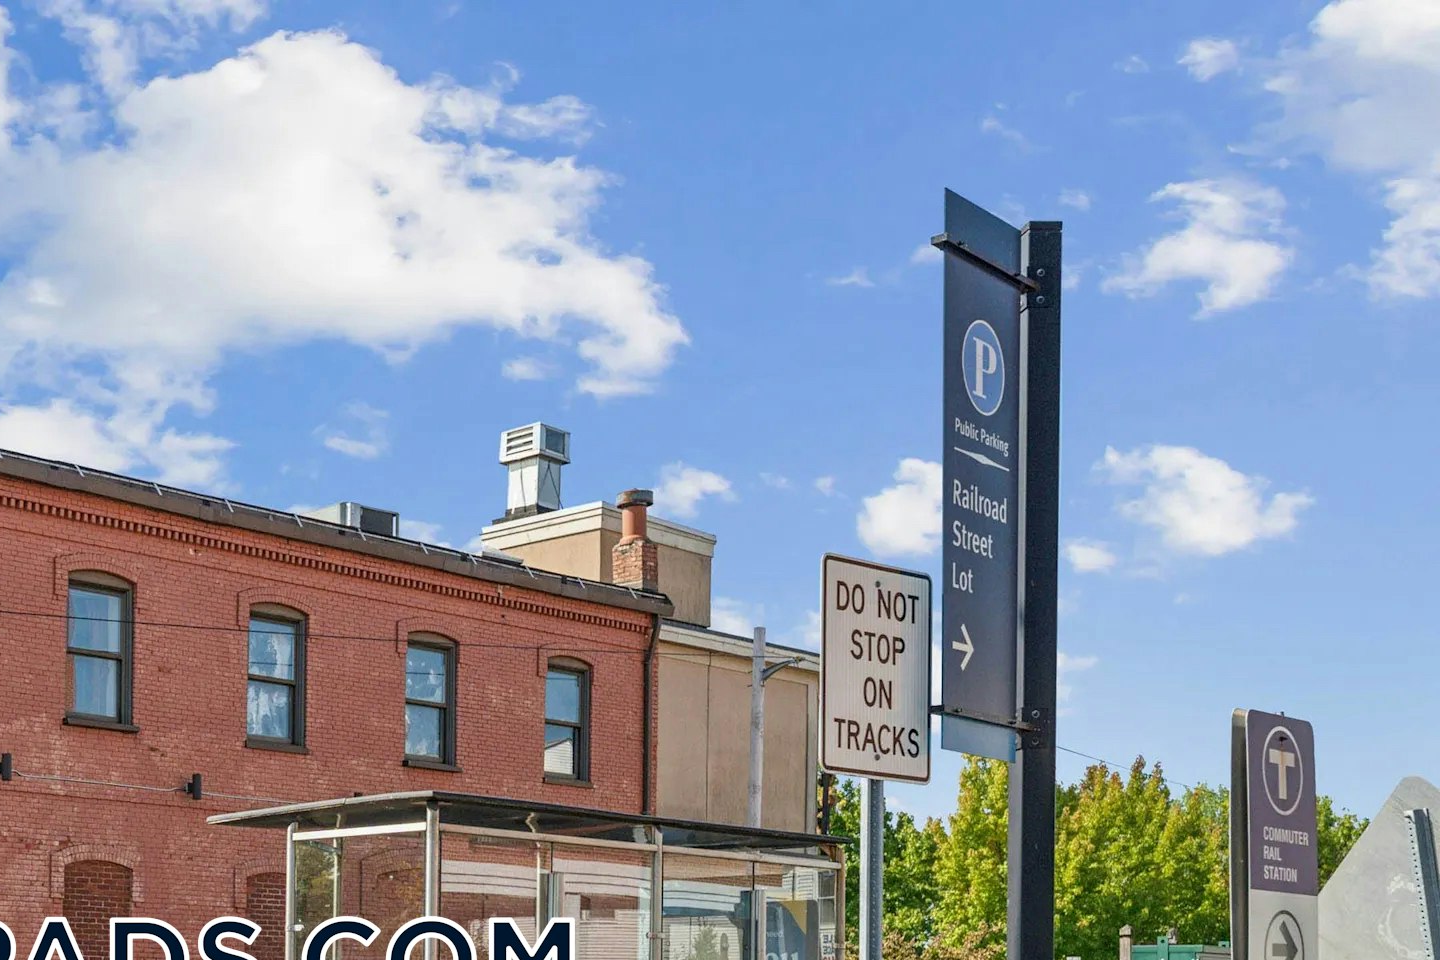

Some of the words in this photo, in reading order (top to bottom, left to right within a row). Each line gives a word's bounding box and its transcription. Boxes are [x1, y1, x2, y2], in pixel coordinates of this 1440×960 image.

[973, 337, 997, 400] P
[955, 417, 979, 442] Public
[981, 428, 1009, 457] Parking
[953, 479, 1007, 524] Railroad
[952, 520, 993, 559] Street
[952, 562, 973, 594] Lot
[836, 580, 865, 615] DO
[877, 588, 919, 624] NOT
[850, 629, 906, 666] STOP
[863, 677, 892, 710] ON
[834, 718, 920, 759] TRACKS
[1269, 748, 1296, 800] T
[1263, 826, 1309, 847] COMMUTER
[1263, 845, 1282, 862] RAIL
[1263, 864, 1298, 883] STATION
